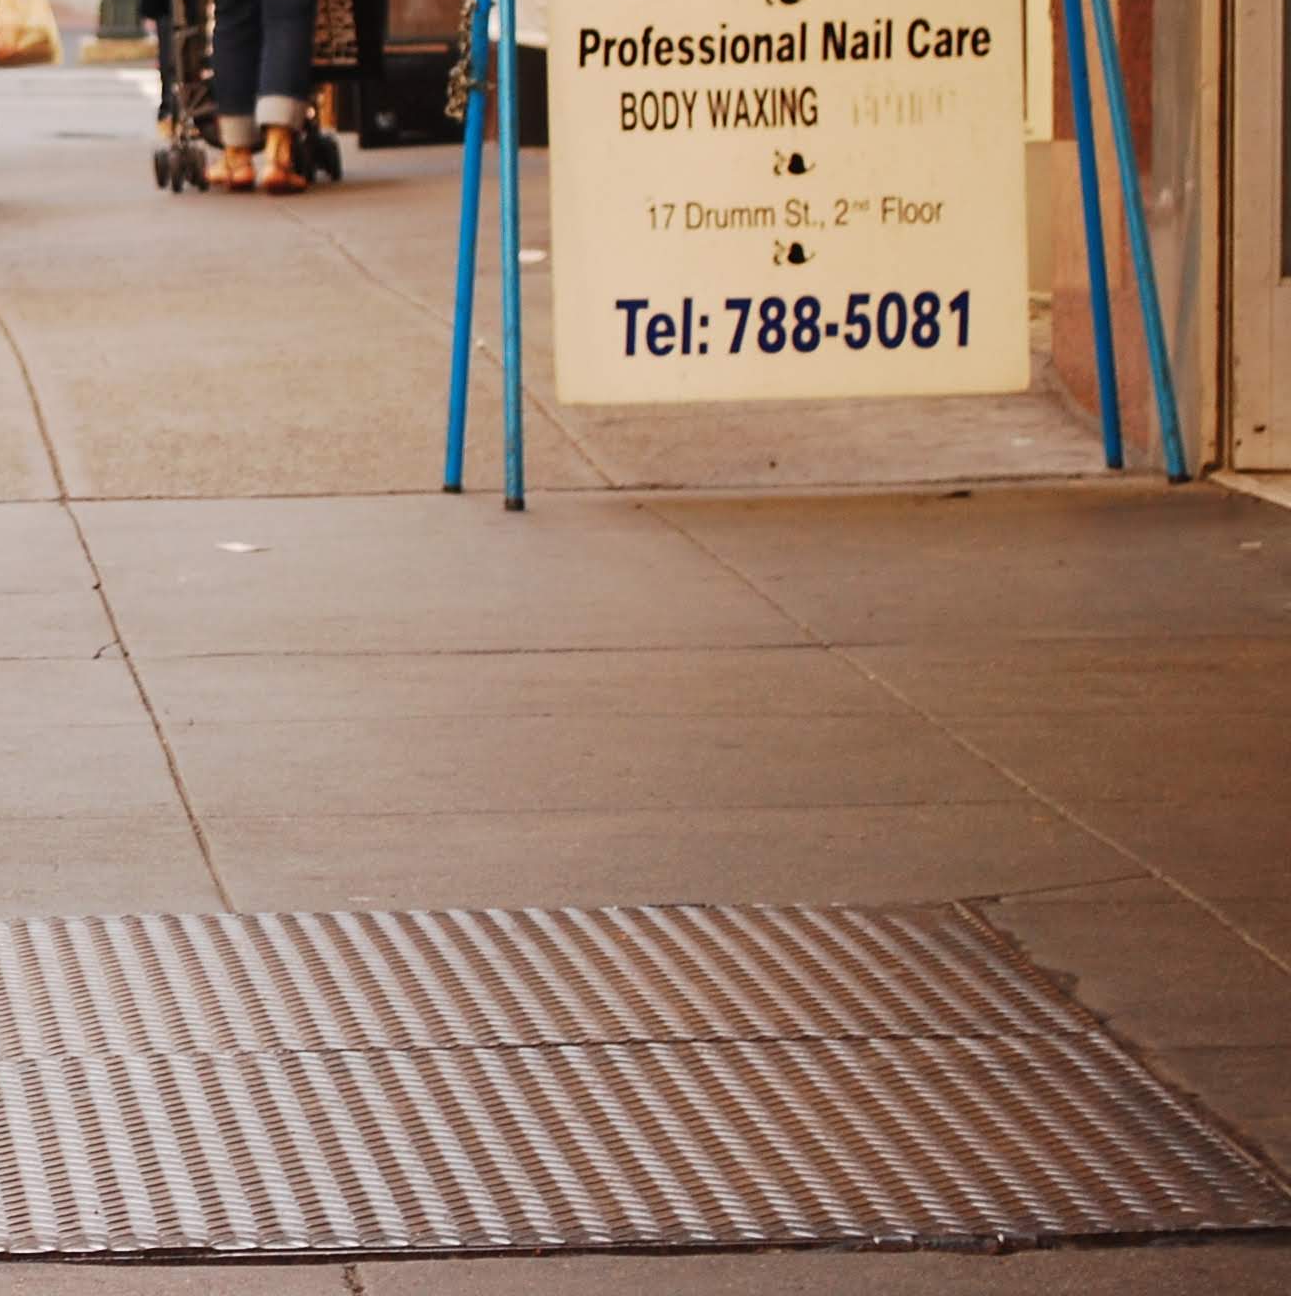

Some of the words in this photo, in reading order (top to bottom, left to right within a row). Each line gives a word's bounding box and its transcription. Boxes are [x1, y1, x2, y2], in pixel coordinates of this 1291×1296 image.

[578, 22, 808, 69] Professional
[821, 18, 894, 62] Nail
[906, 18, 992, 59] Care
[620, 90, 698, 132] BODY
[706, 86, 819, 129] WAXING
[648, 204, 676, 231] 17
[685, 202, 776, 230] Drumm
[880, 196, 944, 225] Floor
[615, 299, 709, 357] Tel:
[725, 291, 972, 355] 788-5081
